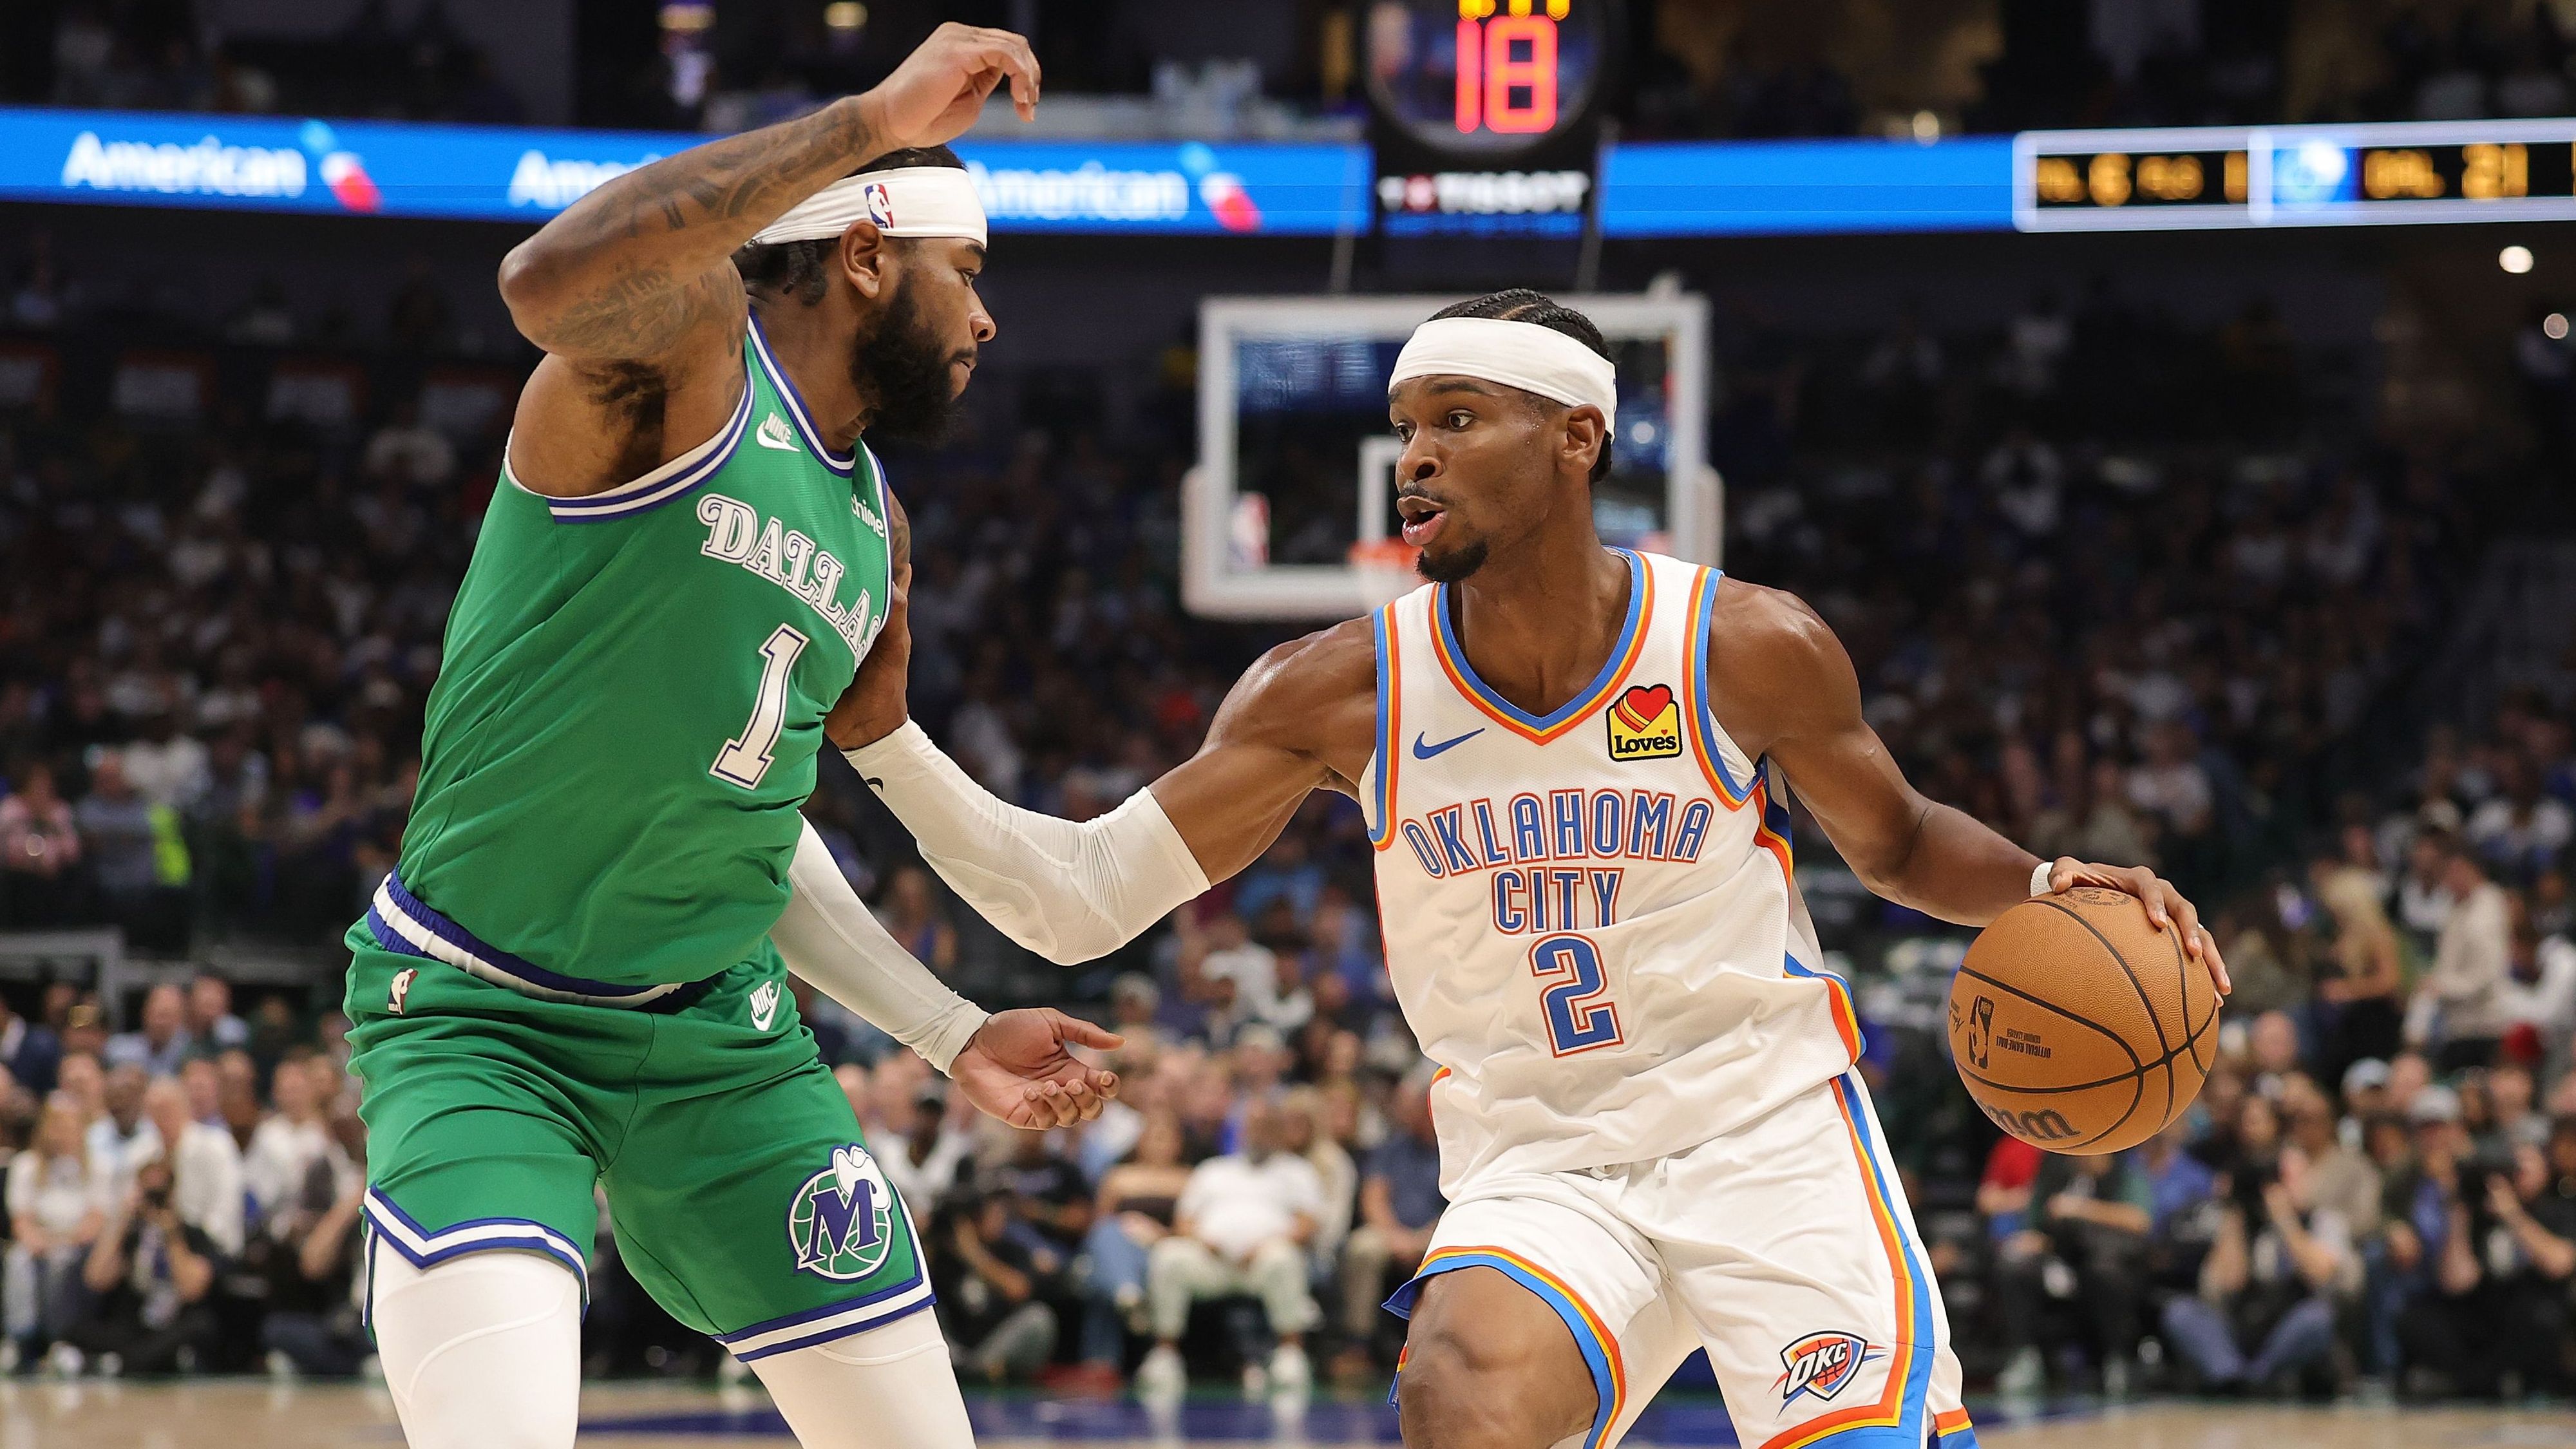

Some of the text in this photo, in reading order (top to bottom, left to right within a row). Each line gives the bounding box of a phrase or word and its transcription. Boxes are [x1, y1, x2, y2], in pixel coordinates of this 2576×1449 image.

[1455, 14, 1558, 134] 18
[61, 131, 307, 198] American
[764, 412, 792, 443] NIKE
[708, 623, 810, 790] 1
[1401, 788, 1714, 878] OKLAHOMA
[1491, 866, 1625, 934] CITY
[749, 980, 773, 1018] NIKE
[1528, 932, 1624, 1058] 2
[798, 1178, 882, 1269] M
[1783, 1341, 1848, 1399] OKC
